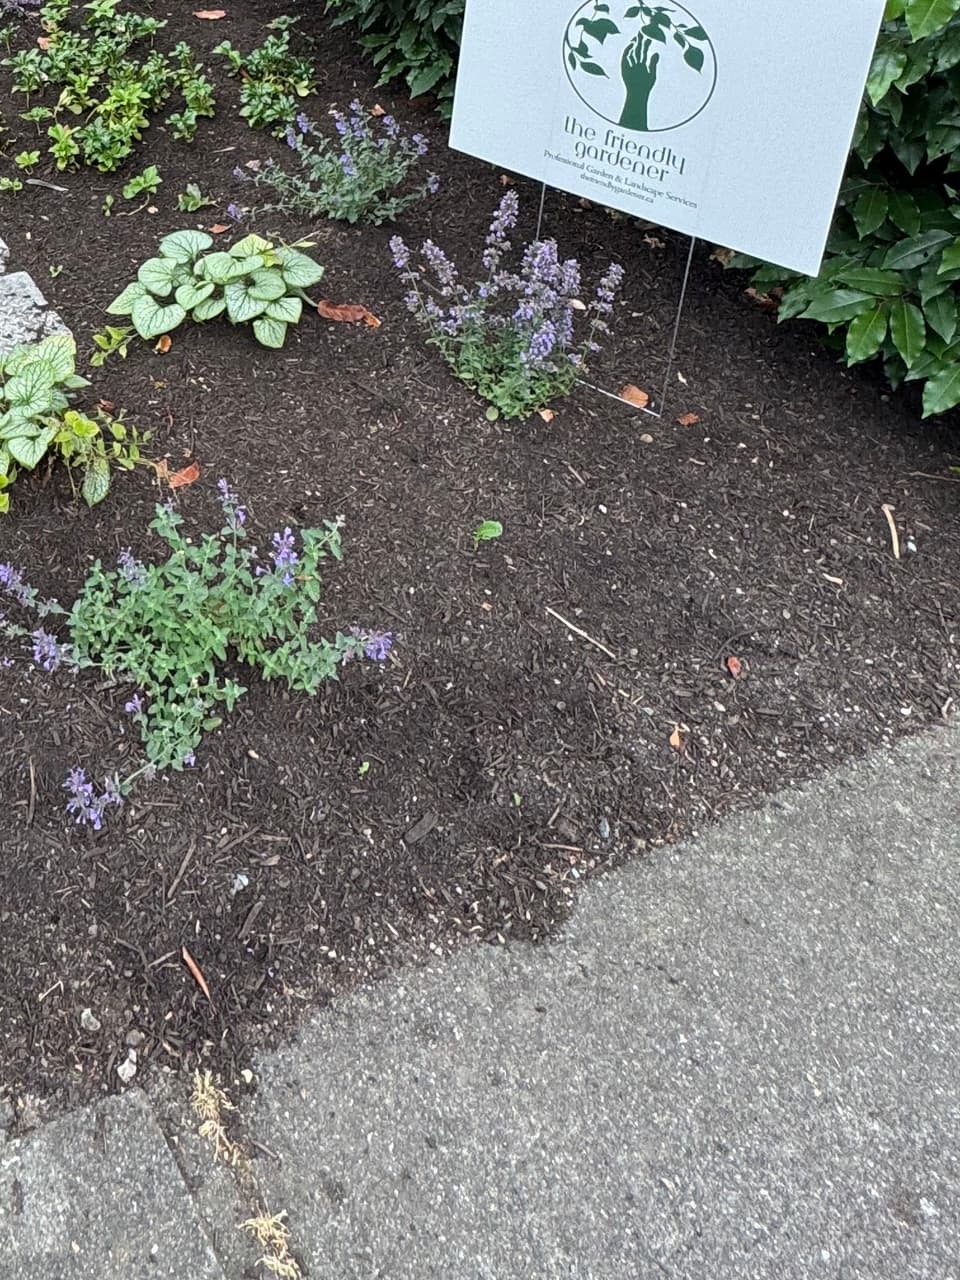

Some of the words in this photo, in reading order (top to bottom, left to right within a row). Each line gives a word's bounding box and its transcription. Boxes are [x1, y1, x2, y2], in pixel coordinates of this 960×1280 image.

[564, 115, 596, 141] the
[604, 128, 686, 175] friendly
[574, 140, 670, 182] gardener
[543, 149, 586, 171] Professional
[585, 163, 614, 180] Garden
[614, 175, 623, 184] &
[624, 177, 665, 198] Landscape
[665, 191, 698, 209] Services
